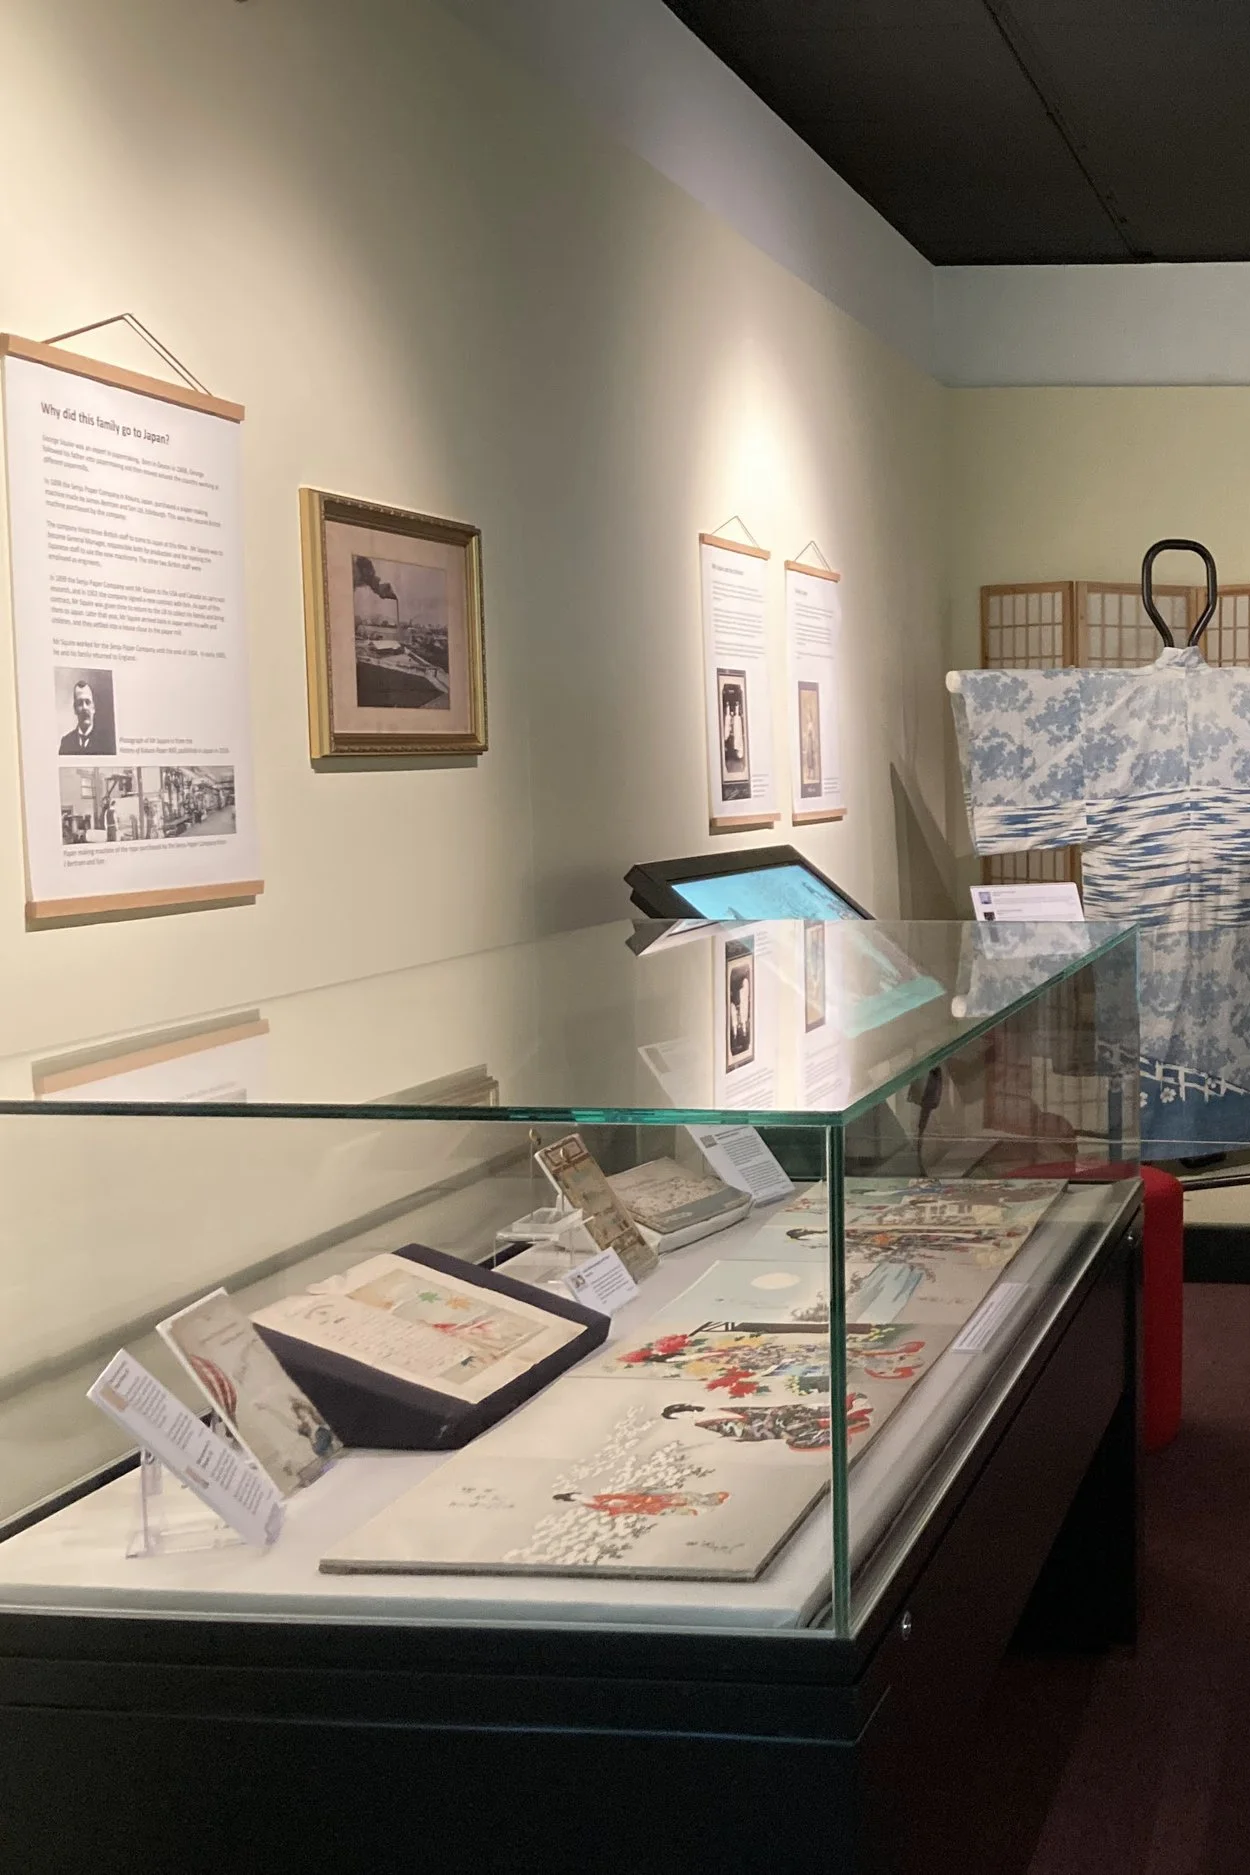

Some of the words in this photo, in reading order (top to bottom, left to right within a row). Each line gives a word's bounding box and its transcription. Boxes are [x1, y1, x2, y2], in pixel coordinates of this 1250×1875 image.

[41, 402, 61, 419] Why
[63, 407, 77, 421] did
[79, 411, 95, 426] this
[96, 416, 120, 435] family
[122, 425, 131, 436] go
[133, 427, 142, 438] to
[143, 429, 170, 444] Japan?
